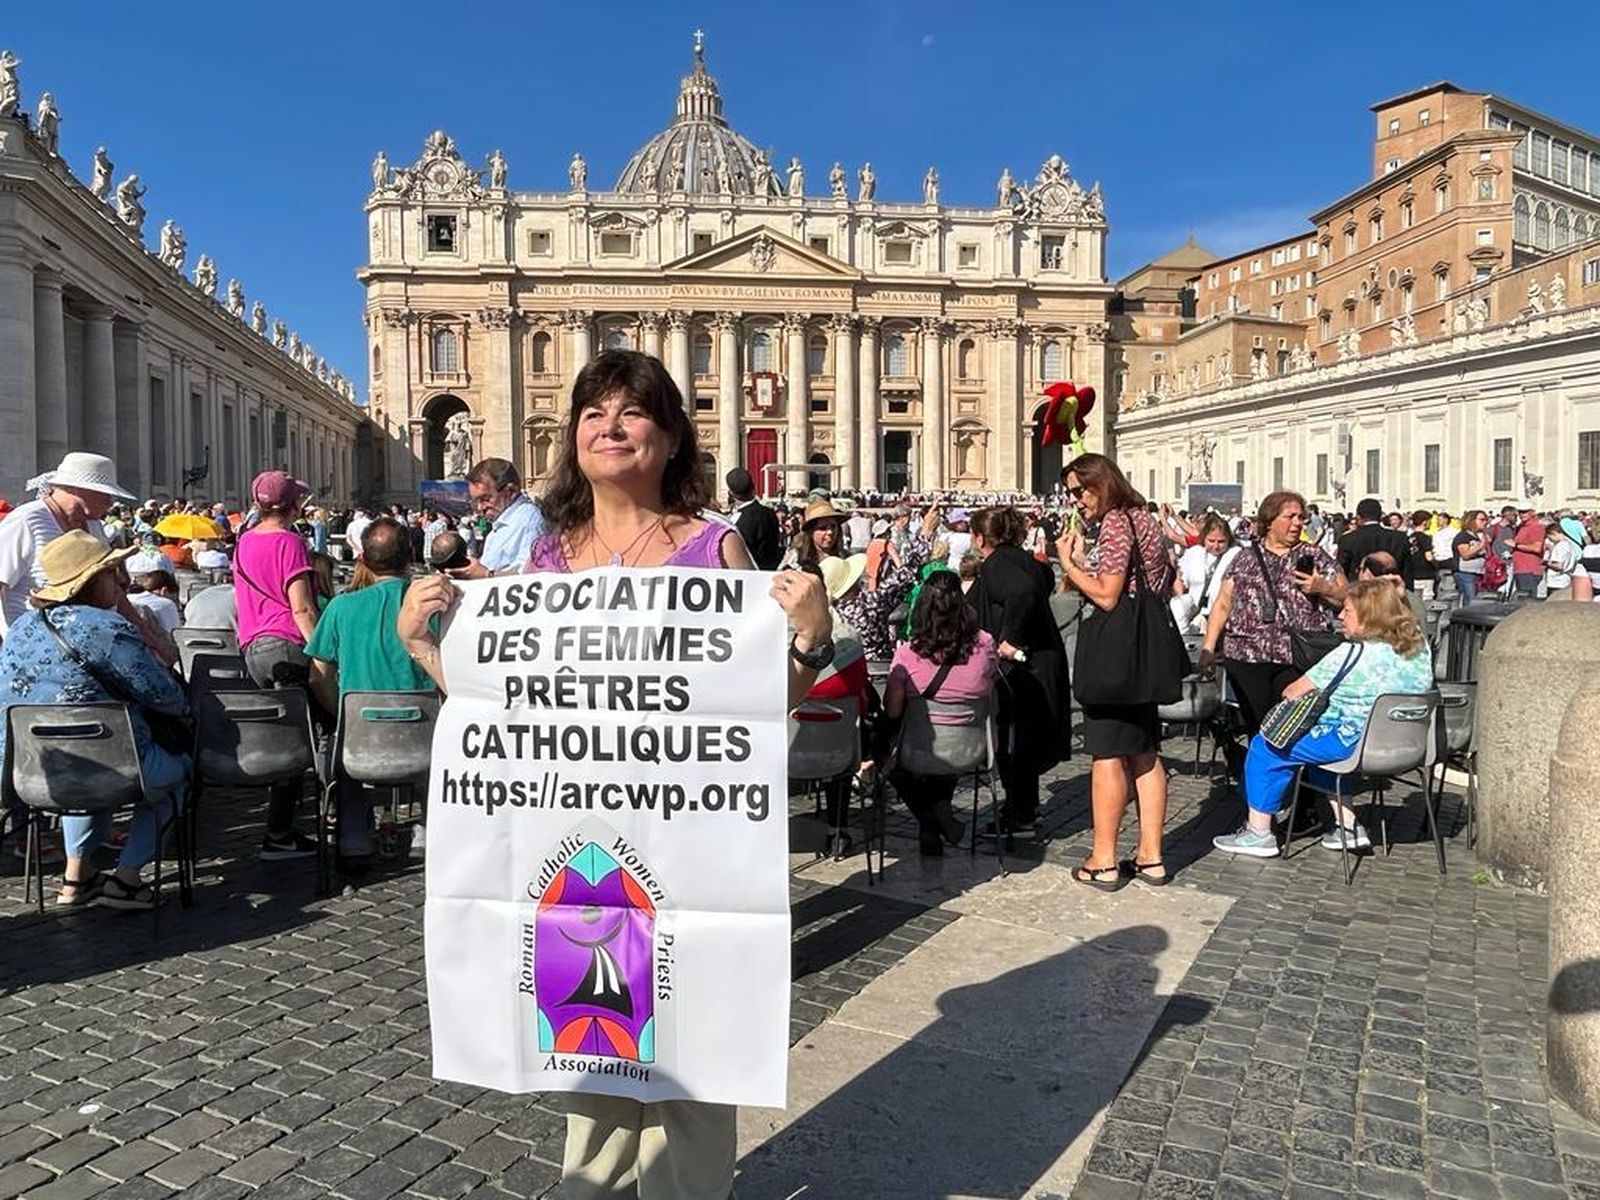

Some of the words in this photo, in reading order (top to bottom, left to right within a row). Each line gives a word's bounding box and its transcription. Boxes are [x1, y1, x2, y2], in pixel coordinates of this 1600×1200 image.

[489, 281, 504, 292] IN
[476, 576, 743, 617] ASSOCIATION
[478, 628, 541, 664] DES
[555, 626, 733, 663] FEMMES
[504, 665, 690, 712] PRÊTRES
[462, 723, 751, 765] CATHOLIQUES
[442, 769, 770, 821] https://arcwp.org
[519, 923, 534, 996] Roman
[527, 833, 585, 900] Catholic
[611, 836, 667, 902] Women
[657, 932, 675, 1001] Priests
[544, 1054, 650, 1083] Association
